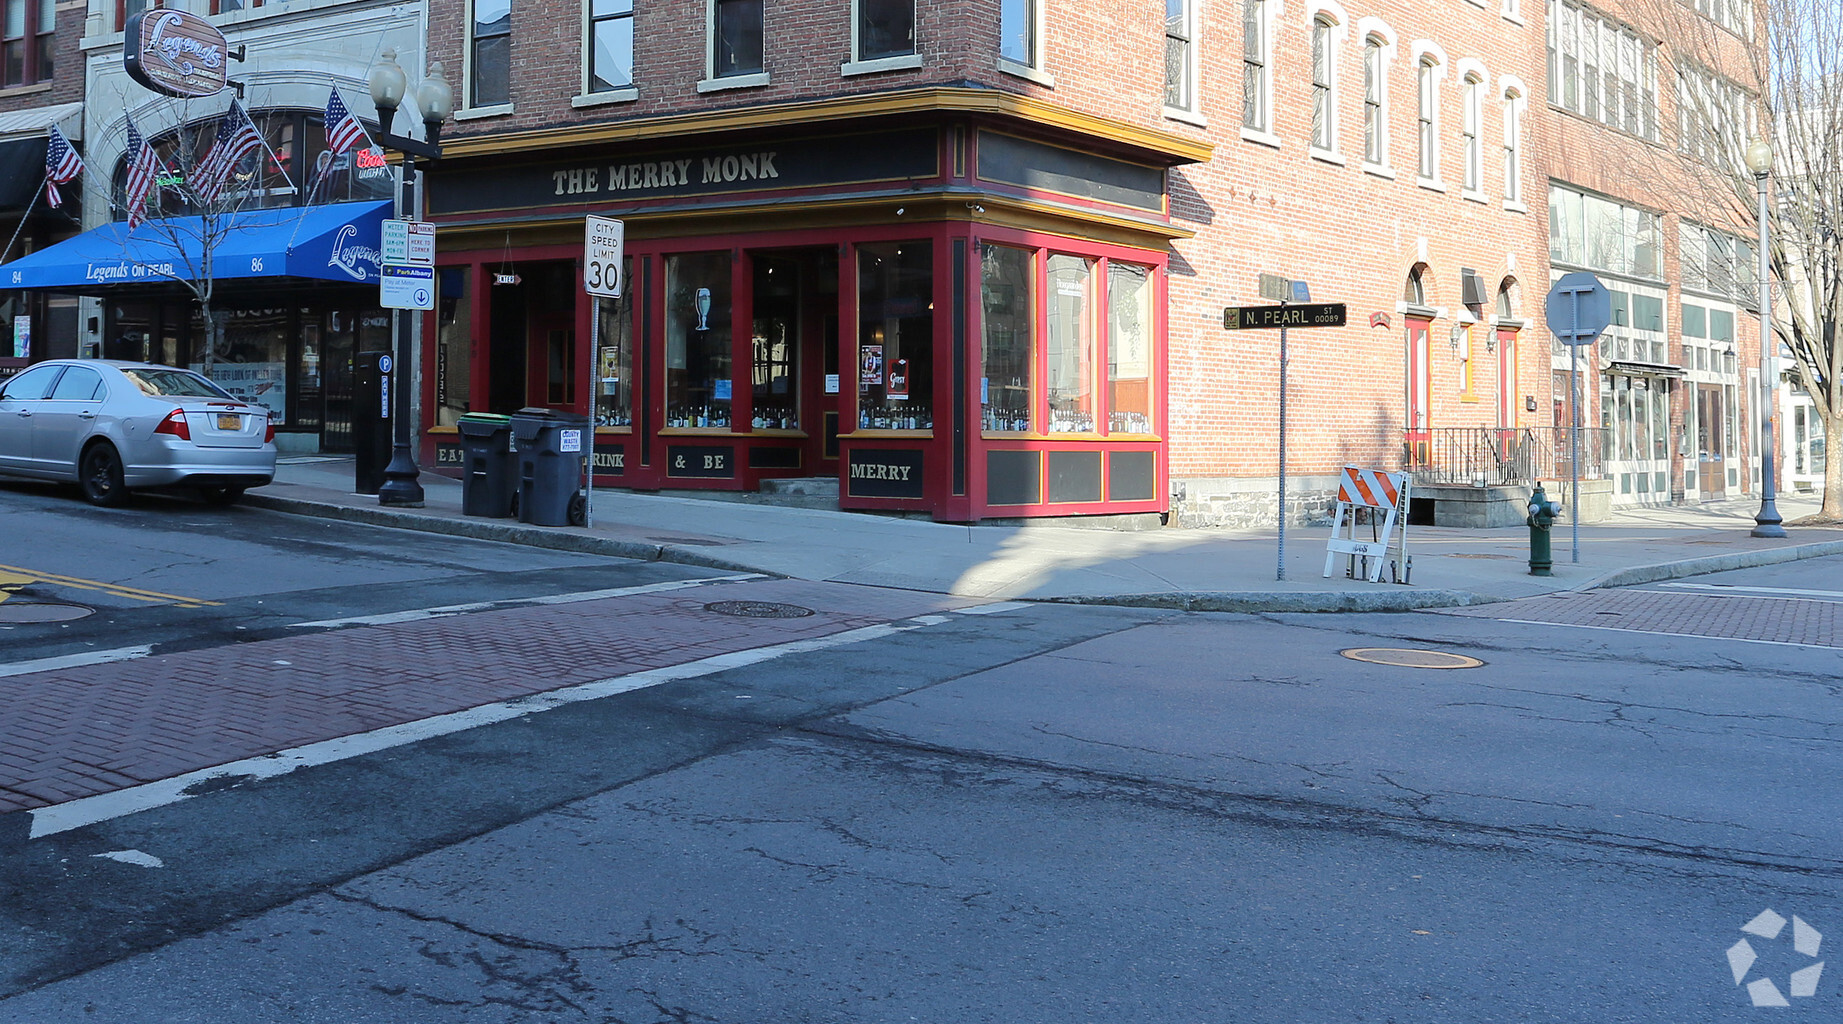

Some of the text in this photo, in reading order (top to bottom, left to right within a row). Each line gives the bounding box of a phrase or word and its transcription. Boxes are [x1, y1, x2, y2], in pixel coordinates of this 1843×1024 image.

[143, 12, 221, 76] Legends
[553, 152, 779, 195] THE MERRY MONK
[385, 231, 406, 239] PARKING
[409, 224, 433, 233] NO PARKING
[596, 223, 615, 234] CITY
[591, 236, 618, 248] SPEED
[593, 250, 615, 260] LIMIT
[86, 261, 175, 282] Legends ON PEARL
[251, 257, 263, 272] 86
[12, 271, 22, 284] 84
[589, 261, 618, 291] 30
[1246, 309, 1309, 325] N. PEARL
[1323, 307, 1333, 315] ST
[1314, 314, 1339, 323] 00089
[438, 448, 464, 463] EAT
[675, 455, 686, 469] &
[703, 455, 724, 469] BE
[850, 463, 911, 481] MERRY
